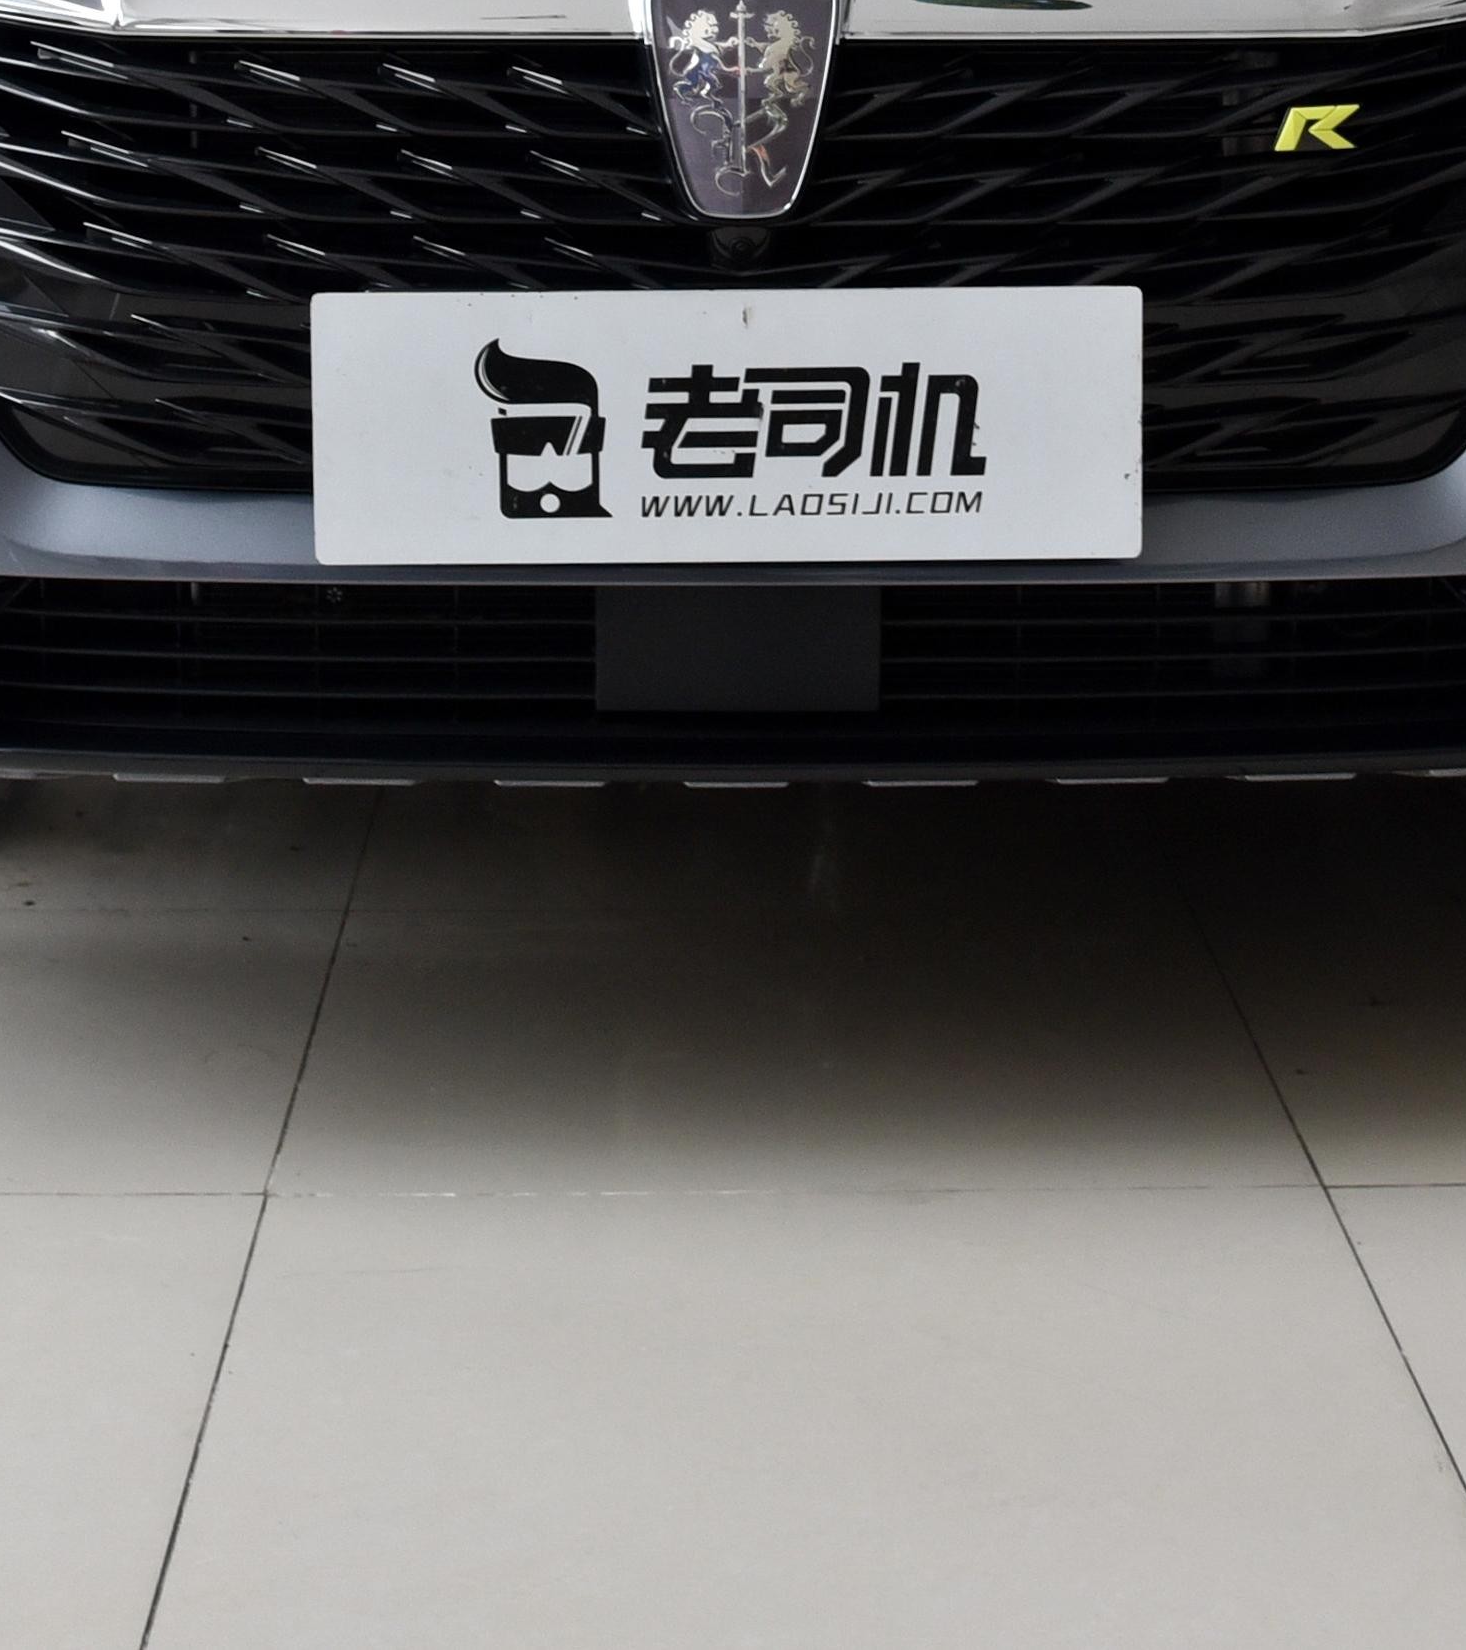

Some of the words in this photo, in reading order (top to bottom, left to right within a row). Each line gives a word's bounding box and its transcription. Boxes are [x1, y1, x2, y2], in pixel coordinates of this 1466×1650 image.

[1274, 103, 1361, 152] R
[640, 361, 988, 479] 老司机
[640, 490, 985, 520] WWW.LAOSIJI.COM
